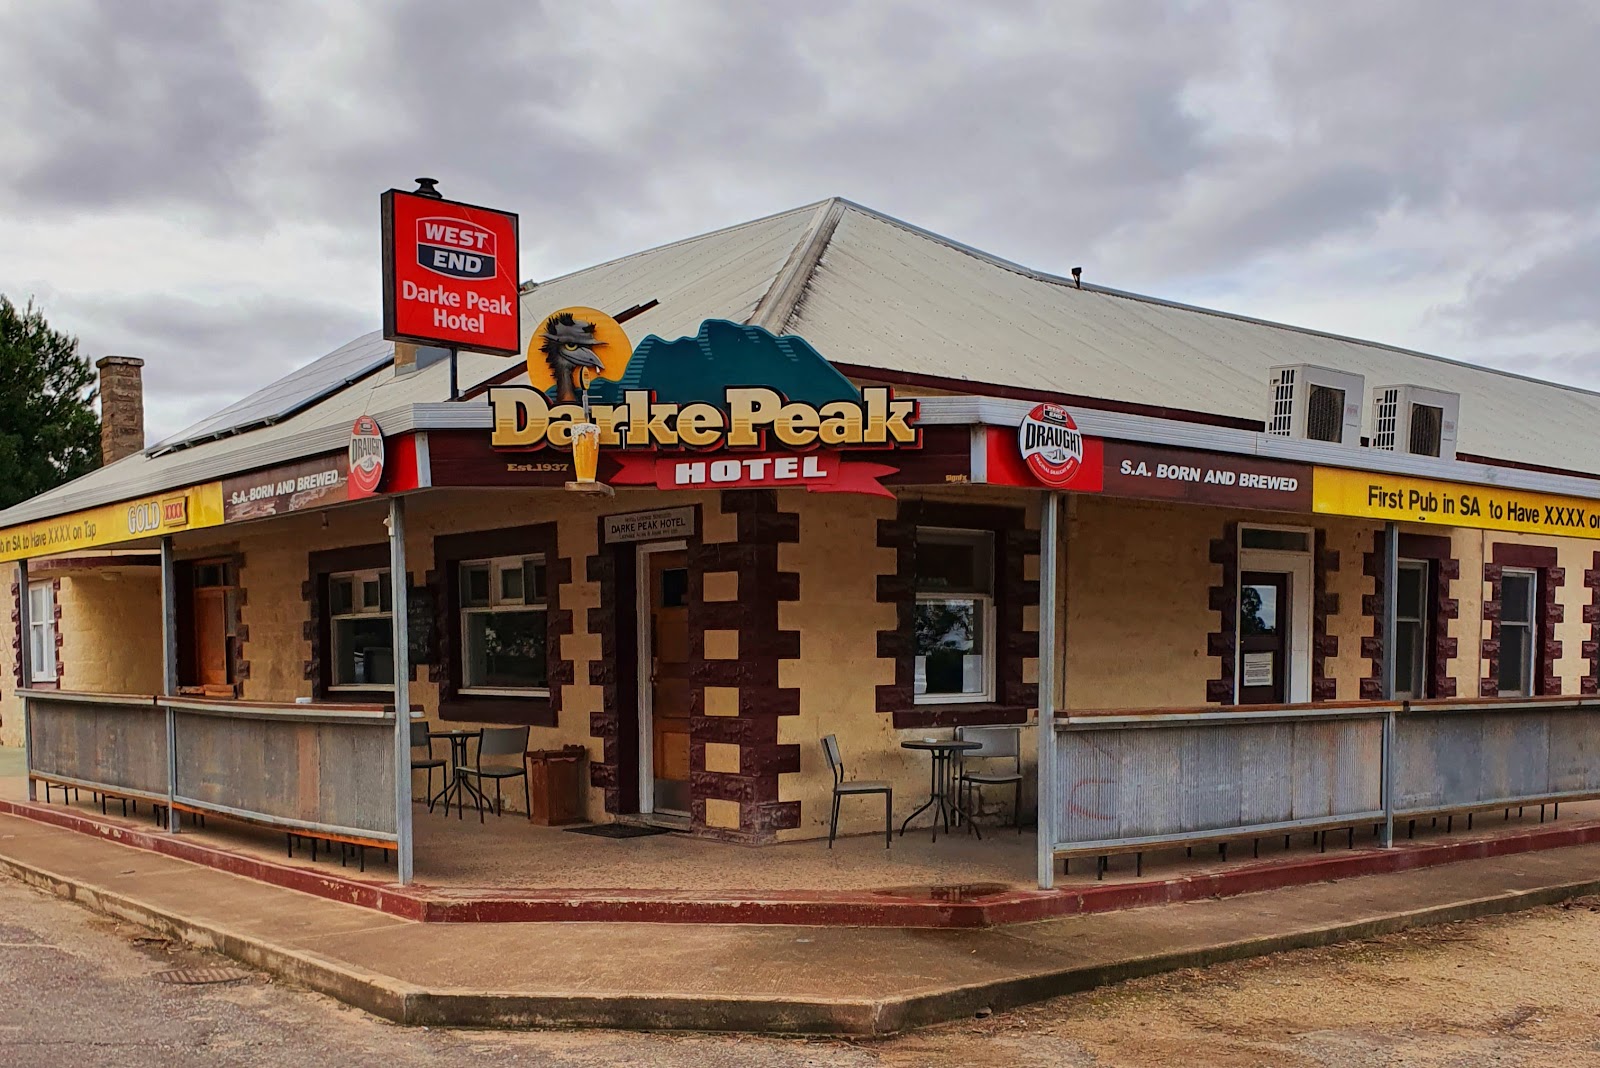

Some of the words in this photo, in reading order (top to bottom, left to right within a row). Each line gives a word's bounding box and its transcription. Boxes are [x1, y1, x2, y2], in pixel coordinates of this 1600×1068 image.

[424, 222, 488, 249] WEST
[433, 250, 482, 274] END
[402, 281, 460, 308] Darke
[466, 291, 512, 316] Peak
[433, 308, 485, 334] Hotel
[489, 387, 724, 447] Darke
[725, 386, 918, 446] Peak
[352, 438, 382, 465] DRAUGHT
[1025, 423, 1081, 457] DRAUGHT
[675, 455, 828, 485] HOTEL
[1120, 459, 1151, 477] S.A.
[1156, 464, 1200, 482] BORN
[1204, 469, 1235, 486] AND
[1238, 473, 1298, 492] BREWED
[231, 490, 248, 505] S.A.
[249, 483, 275, 501] BORN
[276, 480, 295, 496] AND
[297, 469, 339, 492] BREWED
[128, 501, 160, 534] GOLD
[165, 502, 183, 520] XXXX
[1368, 485, 1403, 509] First
[1409, 489, 1438, 512] Pub
[1443, 493, 1454, 515] in
[1460, 495, 1481, 517] SA
[1489, 500, 1502, 520] to
[1507, 501, 1540, 524] Have
[1544, 505, 1585, 528] XXXX
[6, 537, 11, 552] in
[12, 535, 21, 551] SA
[22, 535, 29, 550] to
[31, 531, 47, 548] Have
[48, 523, 71, 545] XXXX
[73, 527, 82, 541] on
[84, 520, 96, 541] Tap
[611, 523, 635, 534] DARKE
[638, 520, 658, 531] PEAK
[660, 517, 686, 529] HOTEL
